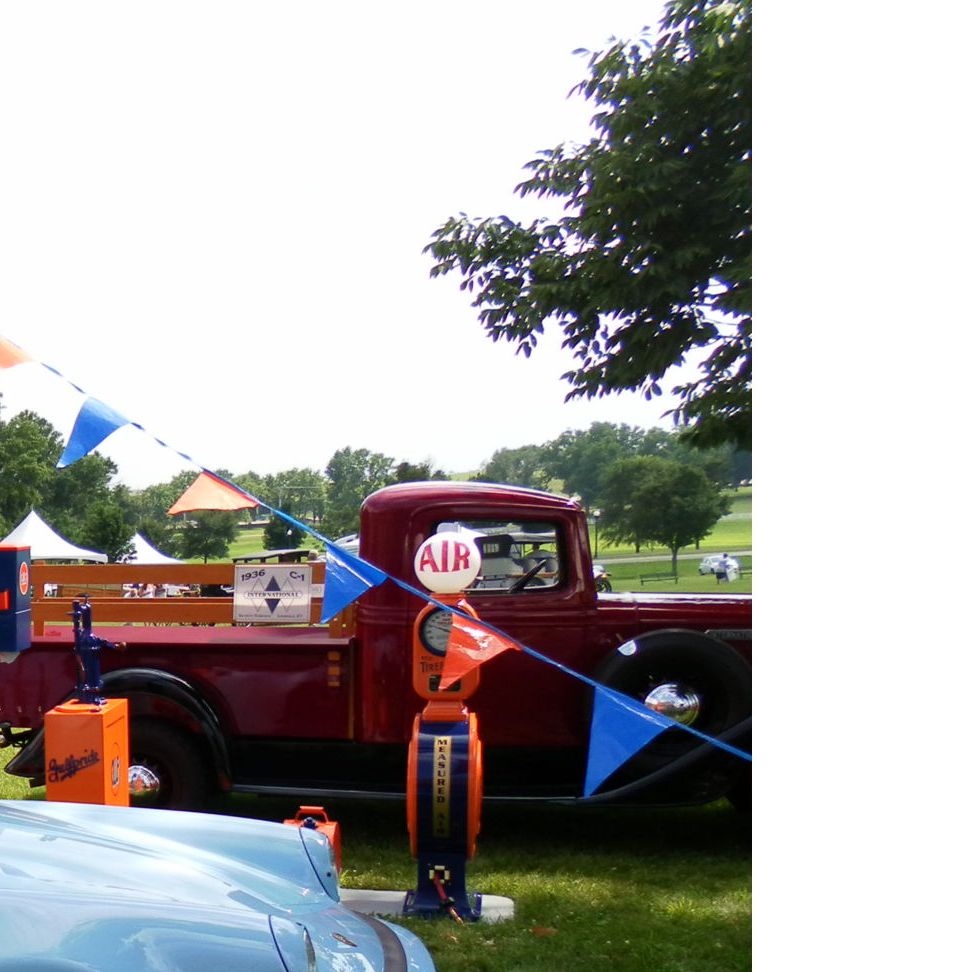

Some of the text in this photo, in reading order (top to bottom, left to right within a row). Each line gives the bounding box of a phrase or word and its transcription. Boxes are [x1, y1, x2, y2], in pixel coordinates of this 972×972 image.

[419, 540, 471, 573] AIR
[241, 569, 305, 581] 1936 C-1
[436, 738, 448, 804] MEASURED
